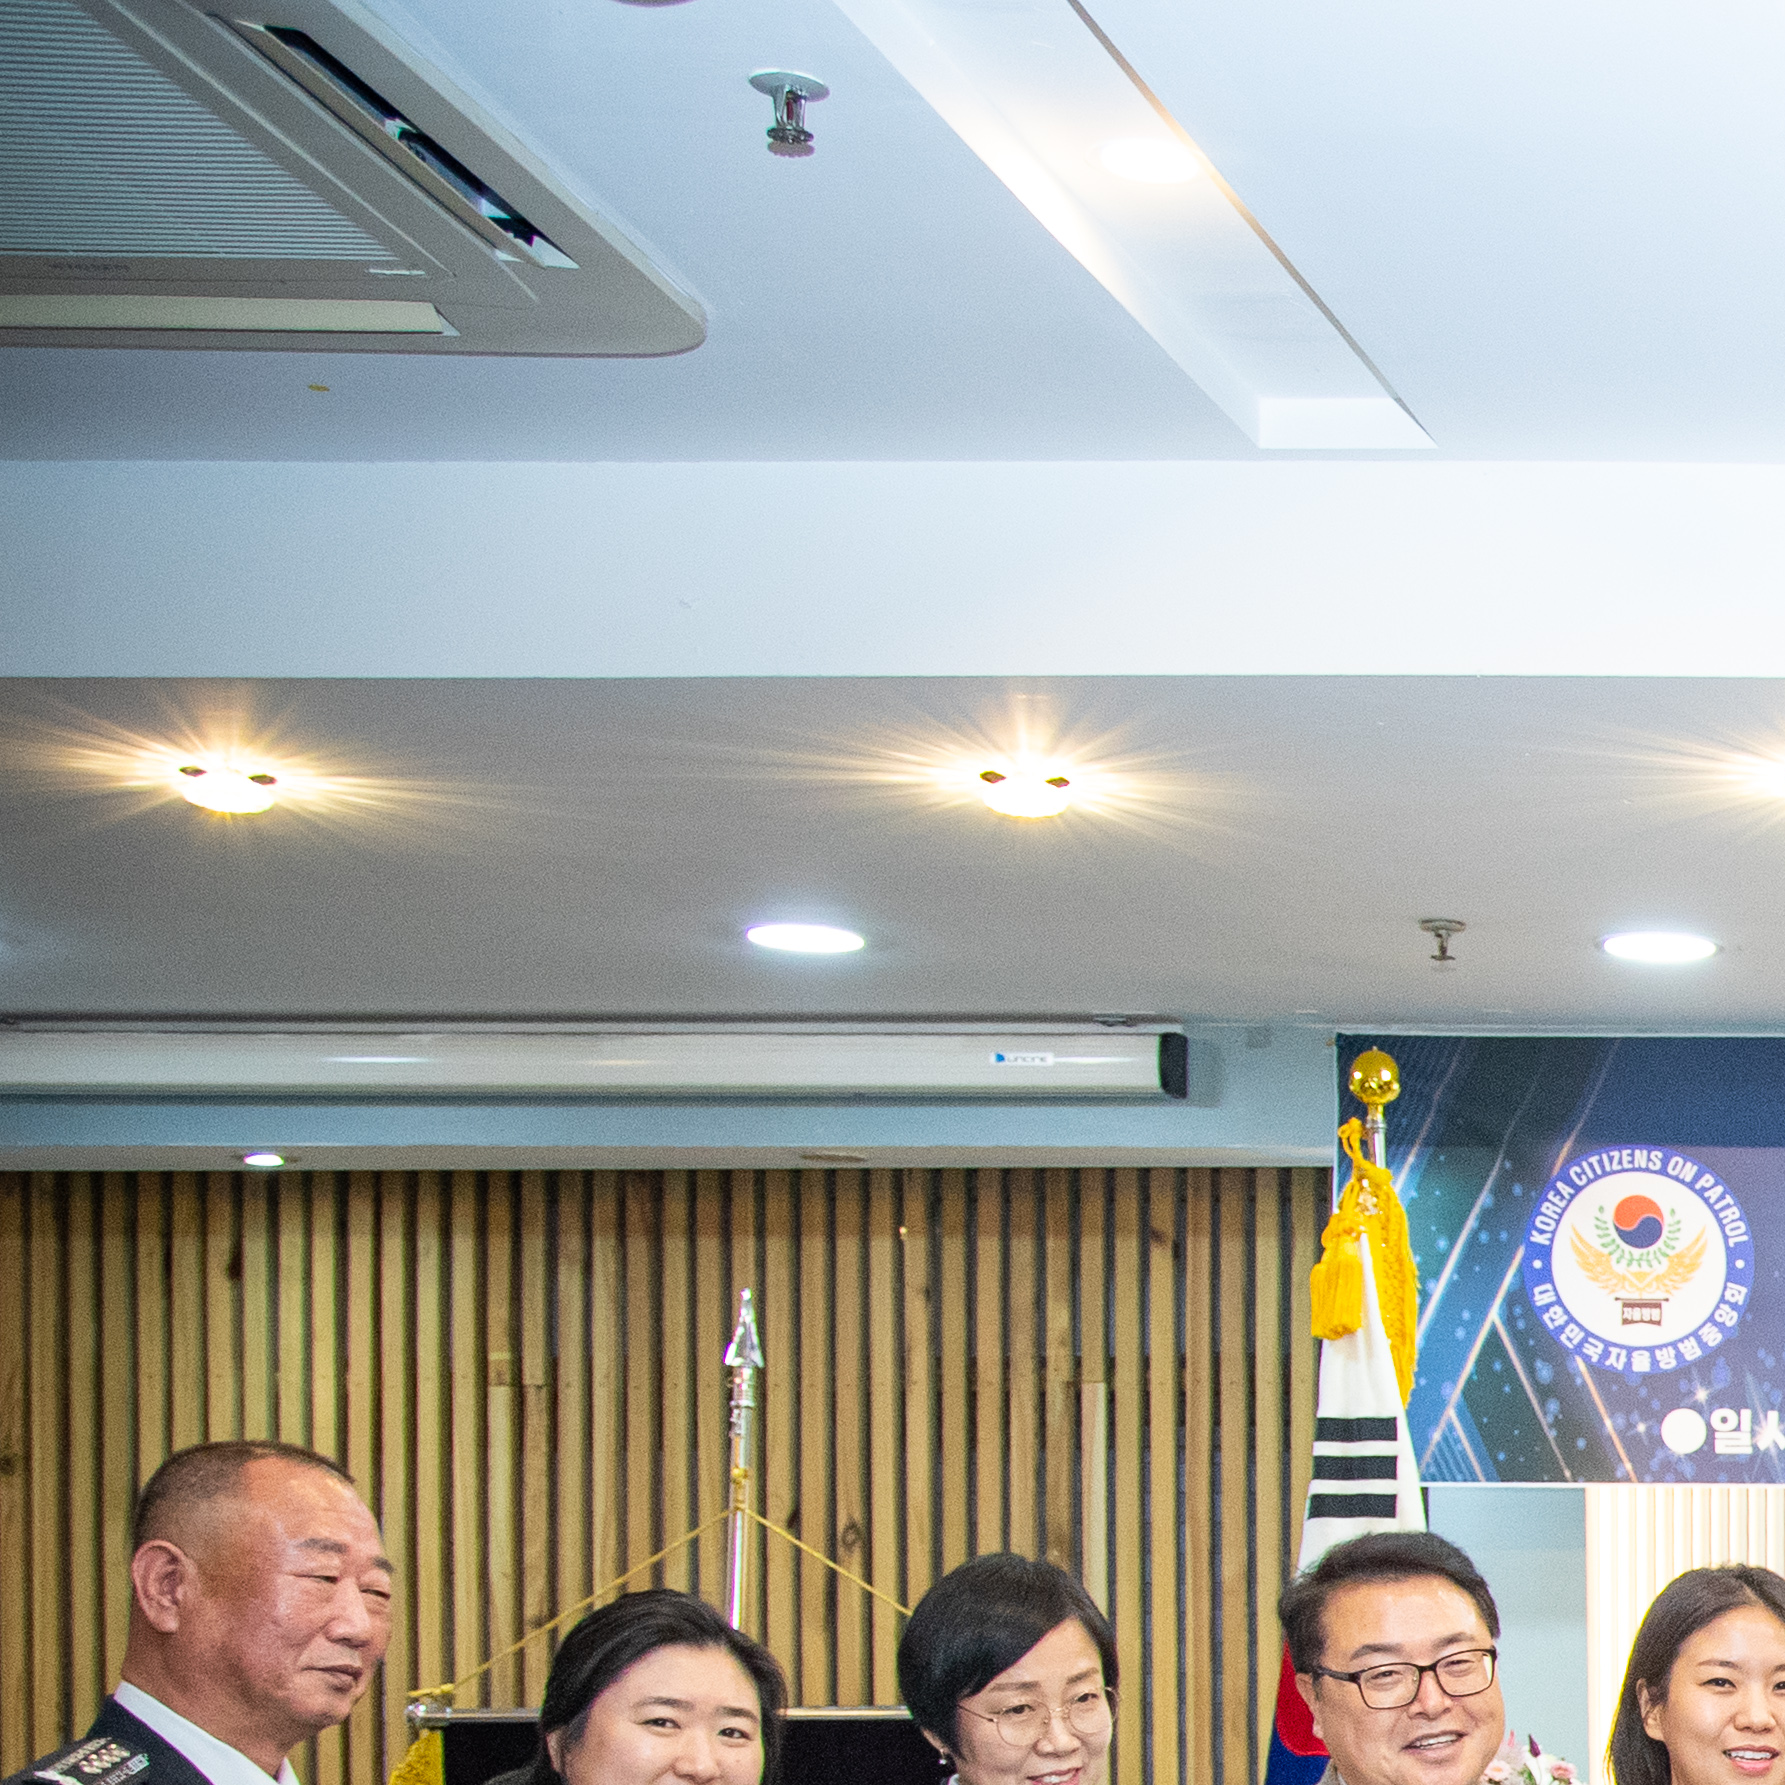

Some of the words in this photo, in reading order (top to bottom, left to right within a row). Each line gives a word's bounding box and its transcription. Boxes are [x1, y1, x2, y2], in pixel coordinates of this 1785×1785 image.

[1530, 1181, 1575, 1245] KOREA
[1569, 1149, 1662, 1187] CITIZENS
[1667, 1156, 1698, 1183] ON
[1694, 1173, 1748, 1247] PATROL
